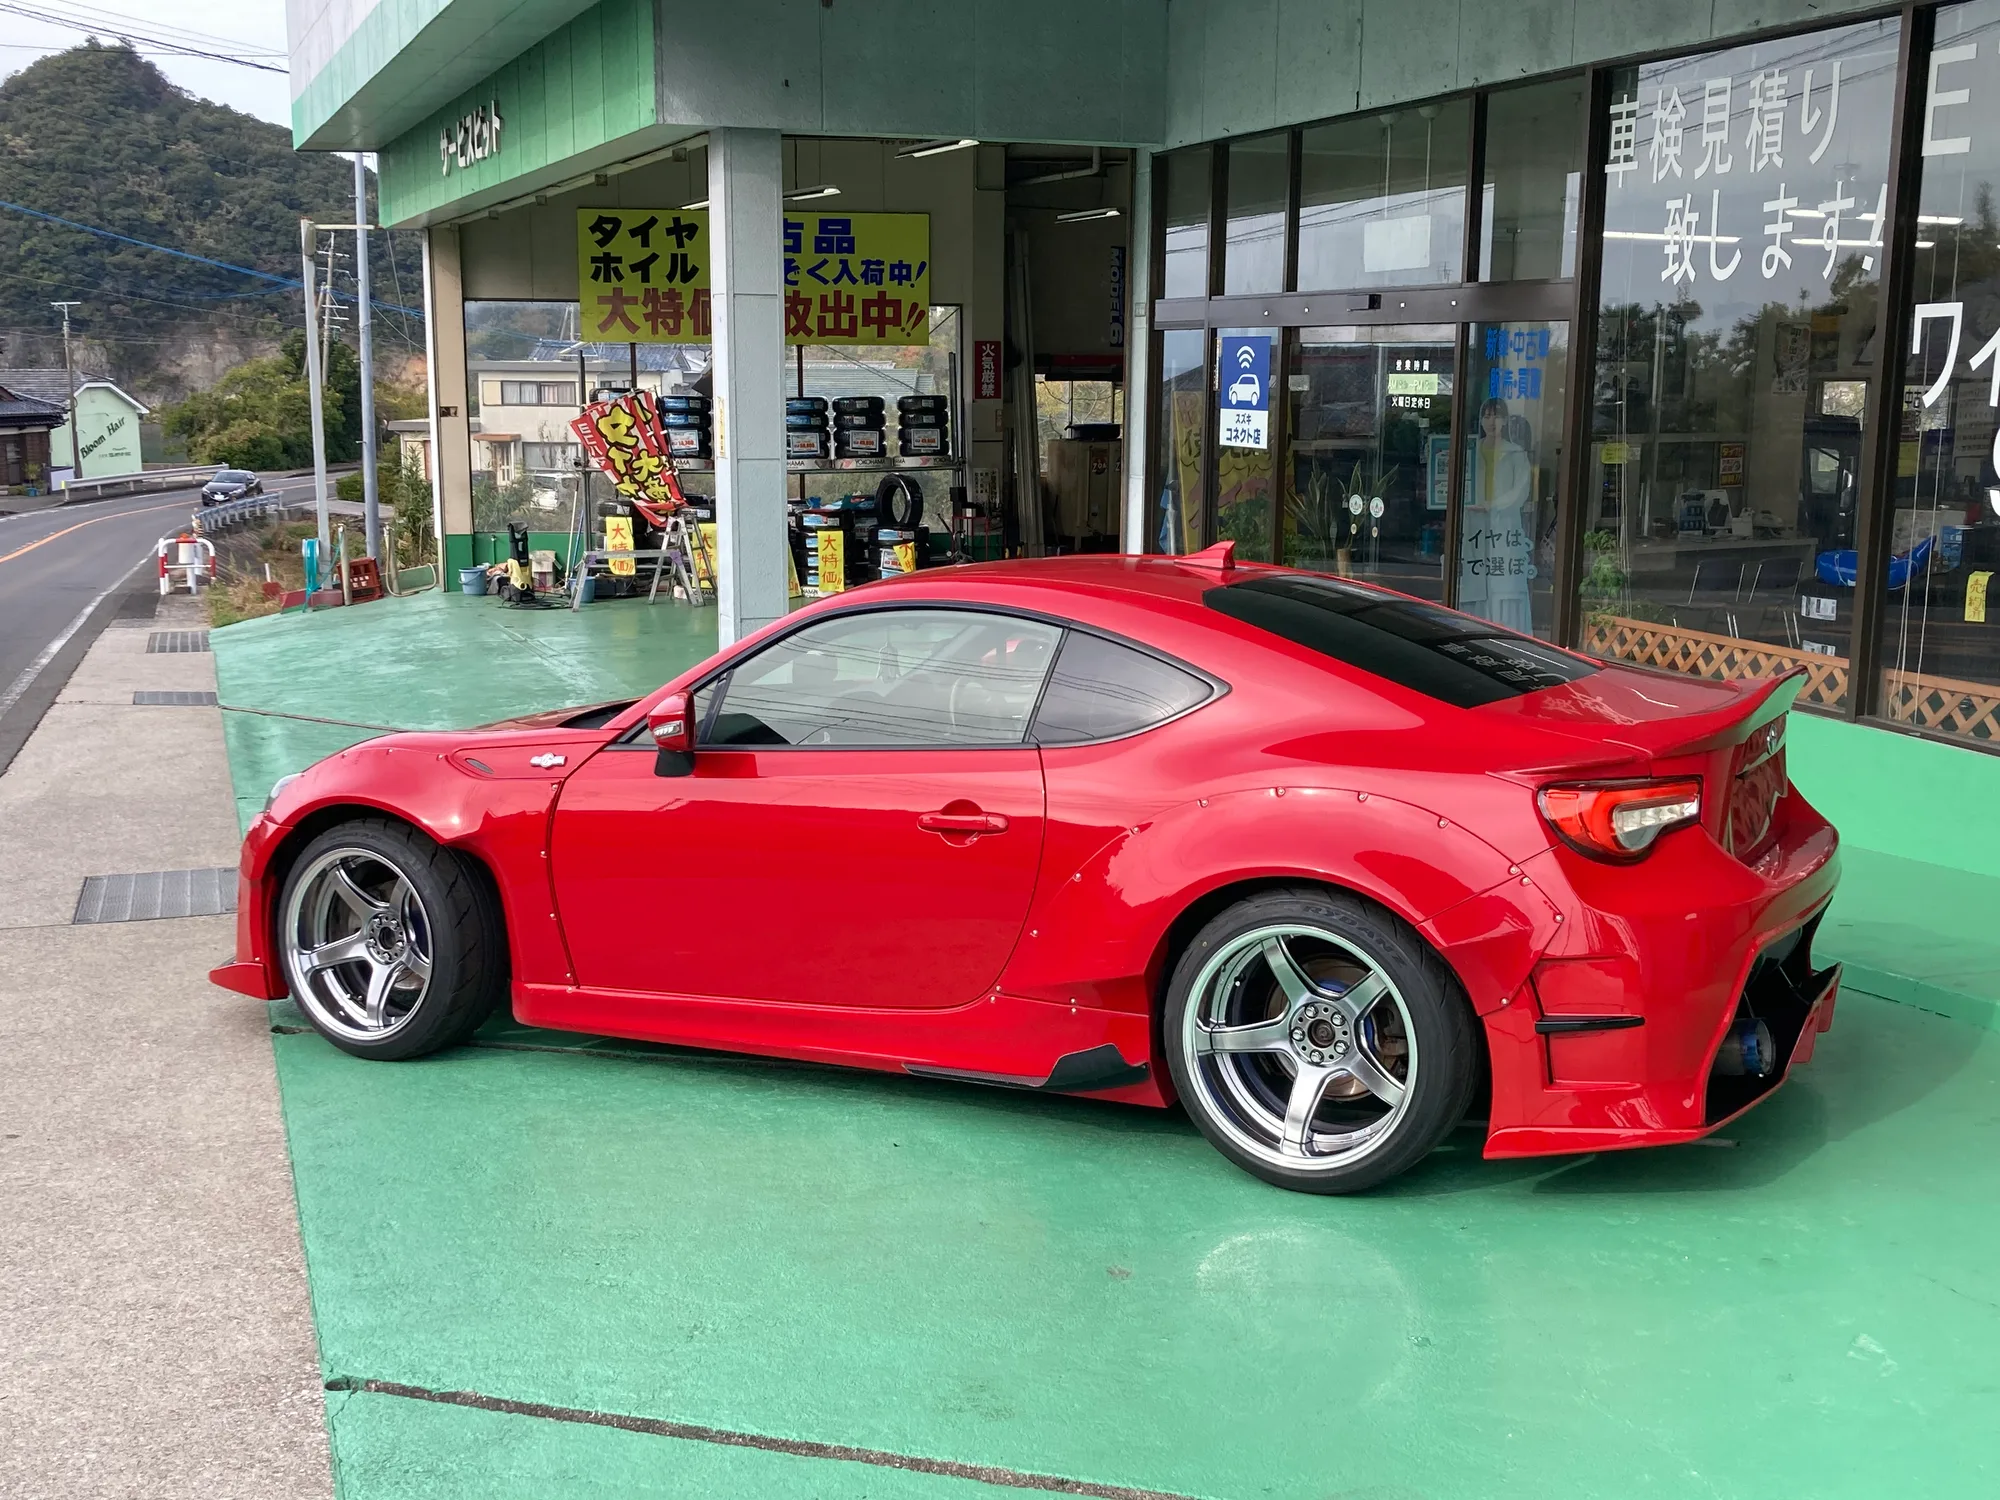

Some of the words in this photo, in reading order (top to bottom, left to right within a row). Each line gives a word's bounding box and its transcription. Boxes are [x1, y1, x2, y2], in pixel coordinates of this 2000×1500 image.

[1605, 61, 1842, 188] 車検見積り
[588, 214, 699, 249] タイヤ
[1661, 180, 1888, 285] 致します!
[590, 252, 700, 284] ホイル
[1110, 247, 1121, 322] MODEL
[981, 343, 995, 397] 火気厳禁
[1235, 413, 1252, 425] スズキ
[1391, 396, 1431, 409] 火曜日定休日
[79, 434, 106, 459] Bloom
[106, 416, 125, 436] Hair
[1225, 427, 1261, 444] コネクト店
[1461, 529, 1530, 549] イヤは、
[1461, 556, 1535, 577] で選ぼ。
